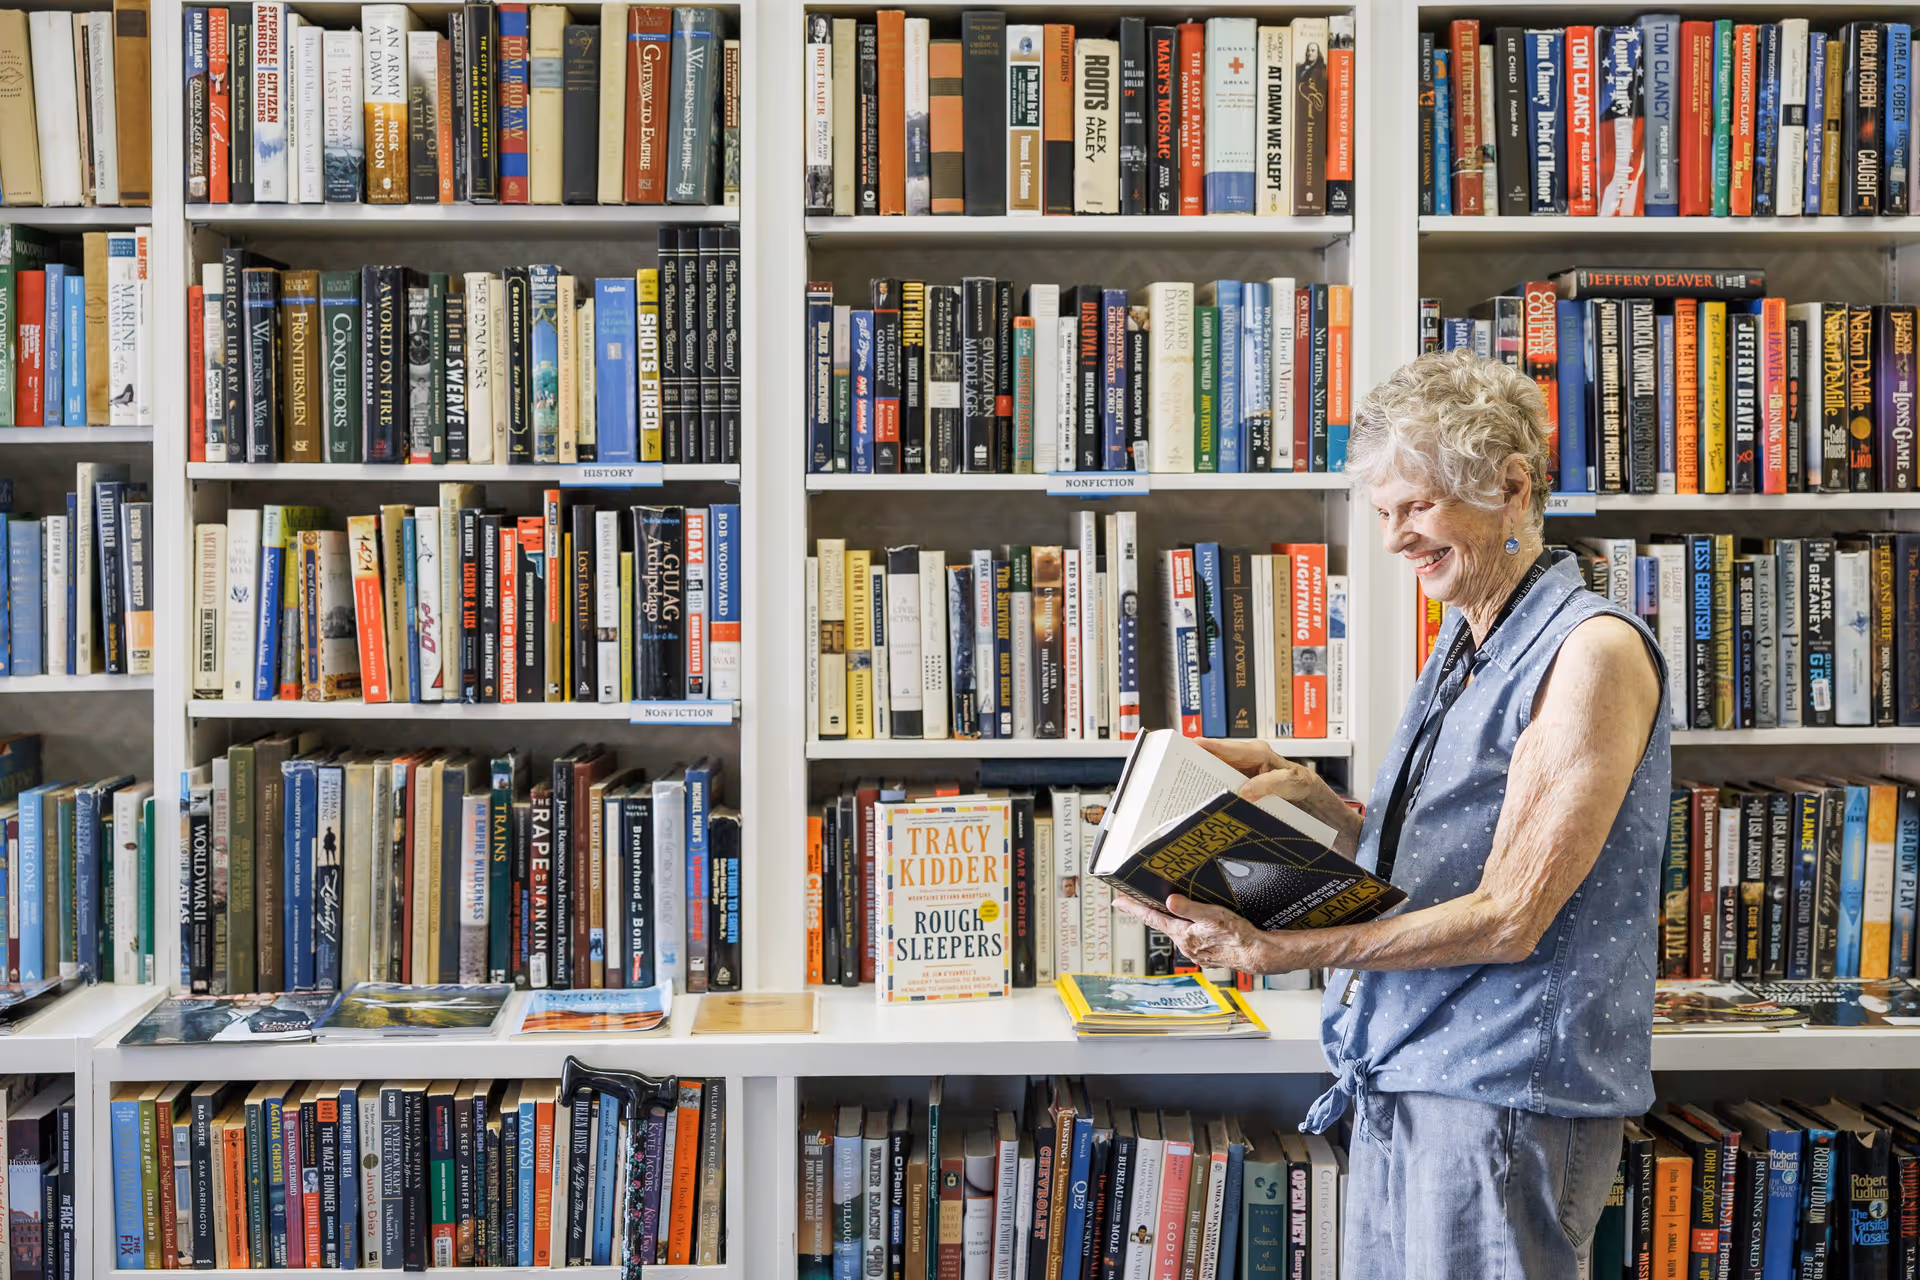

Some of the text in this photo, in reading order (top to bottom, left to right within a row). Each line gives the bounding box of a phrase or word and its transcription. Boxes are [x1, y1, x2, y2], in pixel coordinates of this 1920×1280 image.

[258, 6, 267, 64] AMBROSE
[268, 6, 277, 66] STEPHEN E.
[369, 26, 382, 95] AT DAWN
[388, 27, 399, 98] AN ARMY
[257, 73, 266, 122] SOLDIERS
[268, 73, 278, 123] CITIZEN
[481, 77, 487, 86] OF
[508, 37, 523, 140] TOM BROKAW
[1085, 56, 1109, 110] ROOTS
[1508, 56, 1517, 83] CHILD
[1572, 36, 1589, 135] TOM CLANCY
[1860, 30, 1876, 107] HARLAN COBEN
[681, 46, 703, 170] WILDERNESS EMPIRE
[1158, 40, 1170, 159] MARY'S MOSAIC
[1267, 66, 1282, 191] AT DAWN WE SLEPT
[374, 104, 385, 168] ATKINSON
[389, 121, 398, 152] RICK
[1086, 116, 1095, 162] HALEY
[1097, 117, 1106, 153] ALEX
[1857, 150, 1876, 197] CAUGHT
[1589, 273, 1714, 287] JEFFERY DEAVER
[226, 255, 237, 392] AMERICA'S LIBRARY
[664, 260, 676, 373] This Fabulous Century
[903, 283, 923, 346] OUTRAGE
[1528, 291, 1542, 356] COULTER
[1543, 291, 1556, 355] CATHERINE
[292, 312, 308, 426] FRONTIERSMEN
[332, 313, 351, 427] CONQUERORS
[380, 282, 392, 425] A WORLD ON FIRE
[640, 314, 659, 429] SHOTS FIRED
[1313, 327, 1325, 437] No Farms, No Food
[1736, 323, 1753, 441] JEFFERY DEAVER
[1850, 311, 1871, 410] Nelson DeMille
[446, 358, 464, 425] SWERVE
[584, 469, 633, 477] HISTORY
[1066, 479, 1134, 487] NONFICTION
[688, 519, 702, 562] HOAX
[718, 513, 728, 616] BOB WOODWARD
[642, 536, 662, 621] Archipelago
[663, 541, 679, 621] The GULAG
[997, 567, 1010, 639] The Survivor
[1297, 555, 1309, 640] LIGHTNING
[1313, 566, 1322, 629] PATH LIT BY
[1520, 577, 1536, 597] STATE
[1695, 541, 1710, 639] TESS GERRITSEN
[1809, 564, 1820, 633] GREANEY
[1822, 578, 1831, 619] MARK
[1880, 545, 1891, 641] PELICAN BRIEF
[24, 803, 35, 892] THE BIG ONE
[494, 803, 505, 861] TRAINS
[532, 809, 550, 870] RAPE
[907, 825, 991, 855] TRACY
[1017, 848, 1025, 876] WAR
[1148, 814, 1232, 870] CULTURAL
[1165, 823, 1245, 880] AMNESIA
[1747, 818, 1761, 878] LISA JACKSON
[194, 825, 206, 920] WORLD WAR II
[633, 826, 642, 899] Brotherhood
[900, 855, 997, 886] KIDDER
[1303, 879, 1340, 904] MEMORIES
[806, 874, 822, 929] Cities
[915, 909, 984, 934] ROUGH
[1262, 902, 1303, 927] NECESSARY
[1278, 878, 1356, 926] HISTORY AND THE ARTS
[1322, 882, 1380, 922] JAMES
[1796, 880, 1811, 964] SECOND WATCH
[897, 933, 1002, 961] SLEEPERS
[271, 1103, 282, 1183] AGATHA CHRISTIE
[520, 1114, 533, 1169] YAA GYASI
[538, 1124, 550, 1174] HOMEGOING
[574, 1101, 589, 1154] HELEN HAYES
[323, 1127, 335, 1212] THE MAZE RUNNER
[1034, 1146, 1051, 1239] CHEVROLET
[1073, 1181, 1087, 1210] QE2
[1115, 1156, 1127, 1198] BUREAU
[1809, 1147, 1830, 1224] ROBERT LUDLUM
[1850, 1174, 1887, 1185] Robert
[1850, 1187, 1889, 1201] Ludlum
[60, 1206, 73, 1229] FACE
[1292, 1170, 1306, 1245] OPEN NET
[1852, 1218, 1889, 1230] Parsifal
[121, 1236, 134, 1255] FIX
[1110, 1224, 1120, 1253] MOLE
[1852, 1233, 1889, 1245] Mosaic
